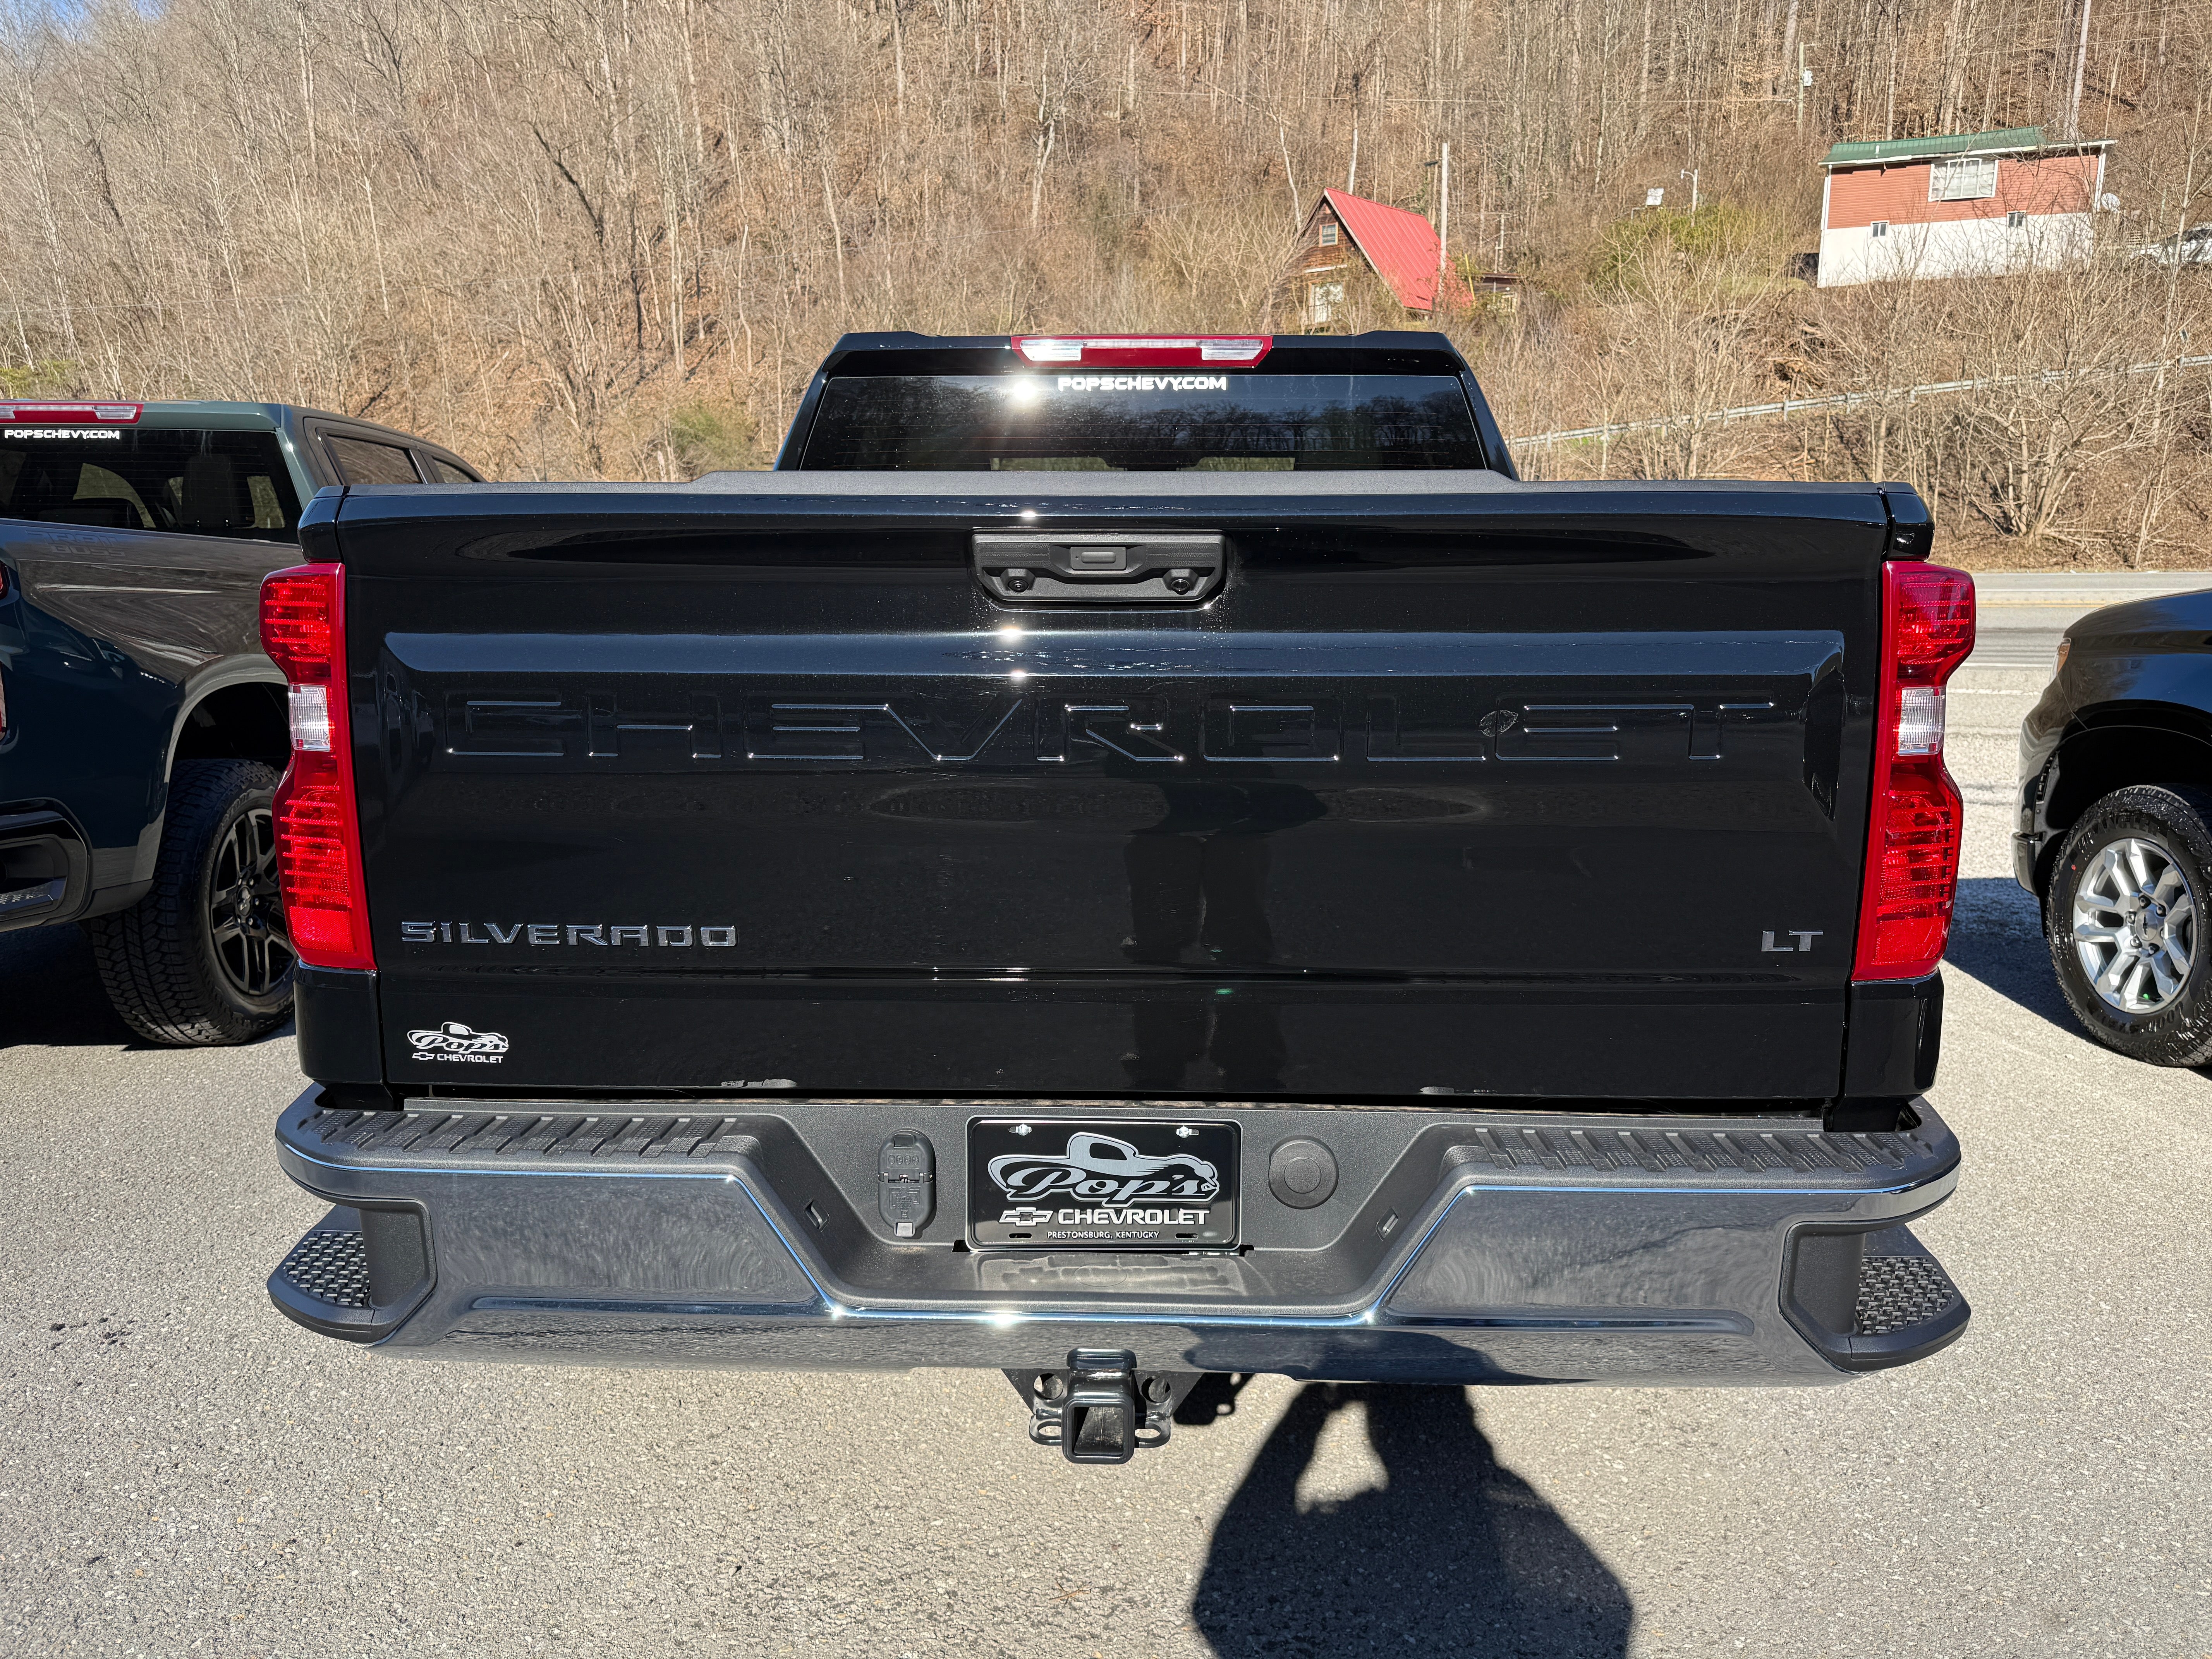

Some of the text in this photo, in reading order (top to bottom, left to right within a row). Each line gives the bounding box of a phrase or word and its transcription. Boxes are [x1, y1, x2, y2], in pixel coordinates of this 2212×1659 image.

[1058, 376, 1226, 391] POPSCHEVY.COM
[5, 429, 120, 440] POPSCHEVY.COM
[50, 545, 126, 557] BOSS
[443, 690, 1774, 761] CHEVROLET
[401, 921, 738, 947] SILVERADO
[1761, 930, 1823, 952] LT
[437, 1053, 503, 1063] CHEVROLET
[1007, 1167, 1205, 1200] Pop's
[1058, 1209, 1210, 1225] CHEVROLET
[1047, 1231, 1159, 1239] PRESTONSBURG, KENTUCKY
